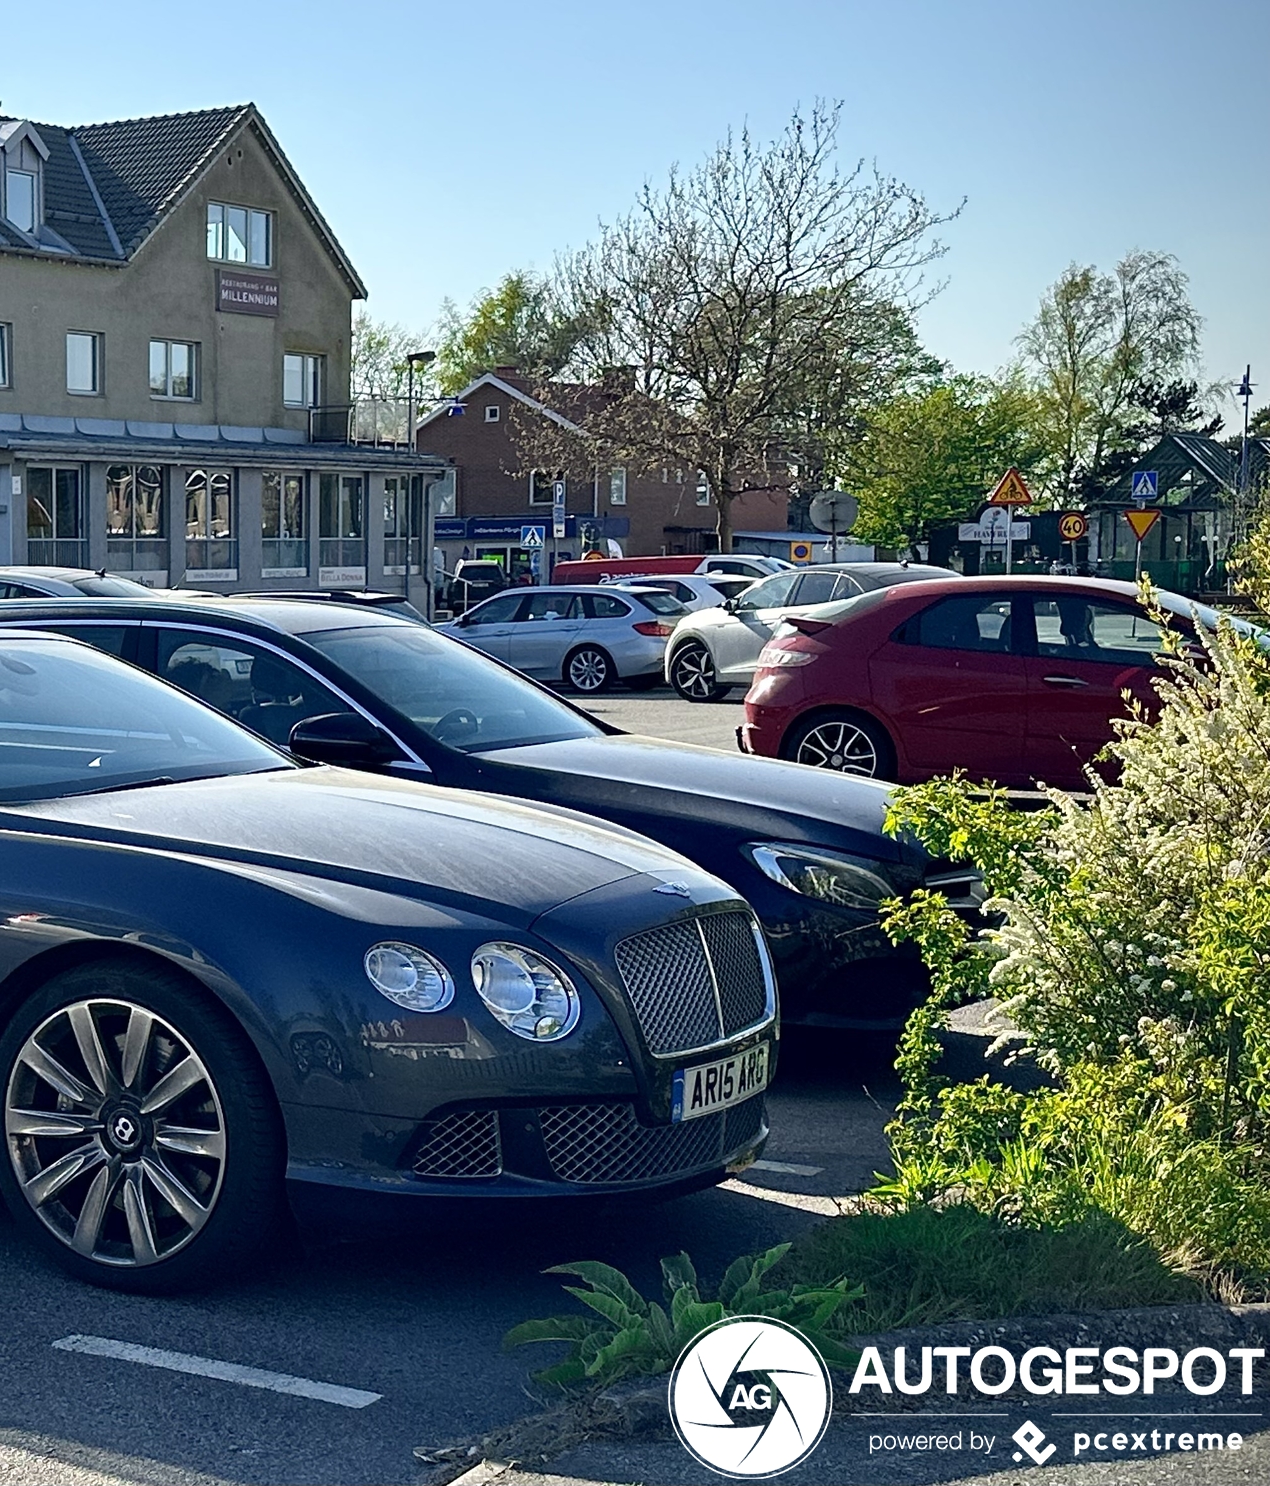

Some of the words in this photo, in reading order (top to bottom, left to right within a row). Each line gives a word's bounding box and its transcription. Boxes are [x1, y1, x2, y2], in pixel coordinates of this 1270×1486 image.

[221, 289, 278, 306] MILLENNIUM
[1063, 520, 1082, 535] 40
[690, 1061, 735, 1110] AR15
